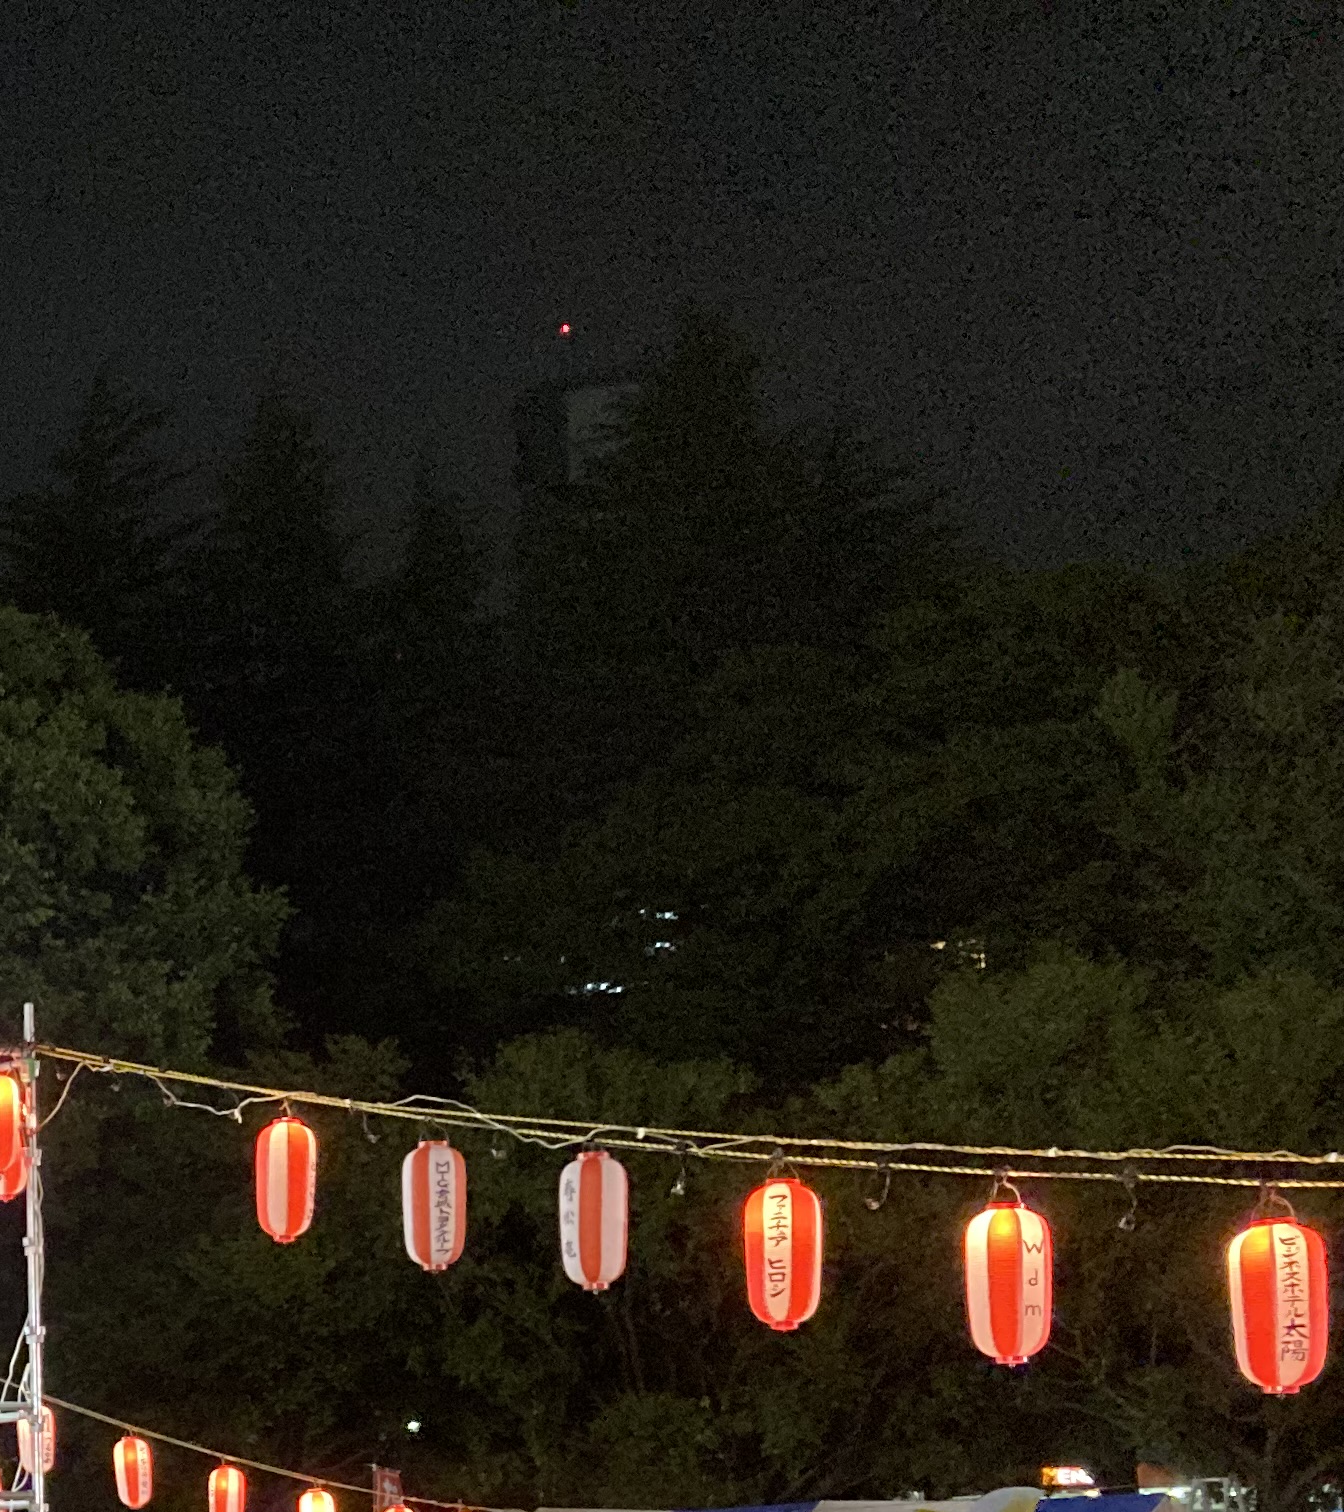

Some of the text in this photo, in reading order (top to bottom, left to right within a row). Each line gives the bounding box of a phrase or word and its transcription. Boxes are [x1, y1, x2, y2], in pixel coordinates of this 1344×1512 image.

[768, 1258, 786, 1298] ヒロシ
[1278, 1235, 1310, 1362] ビジネスホテル太陽
